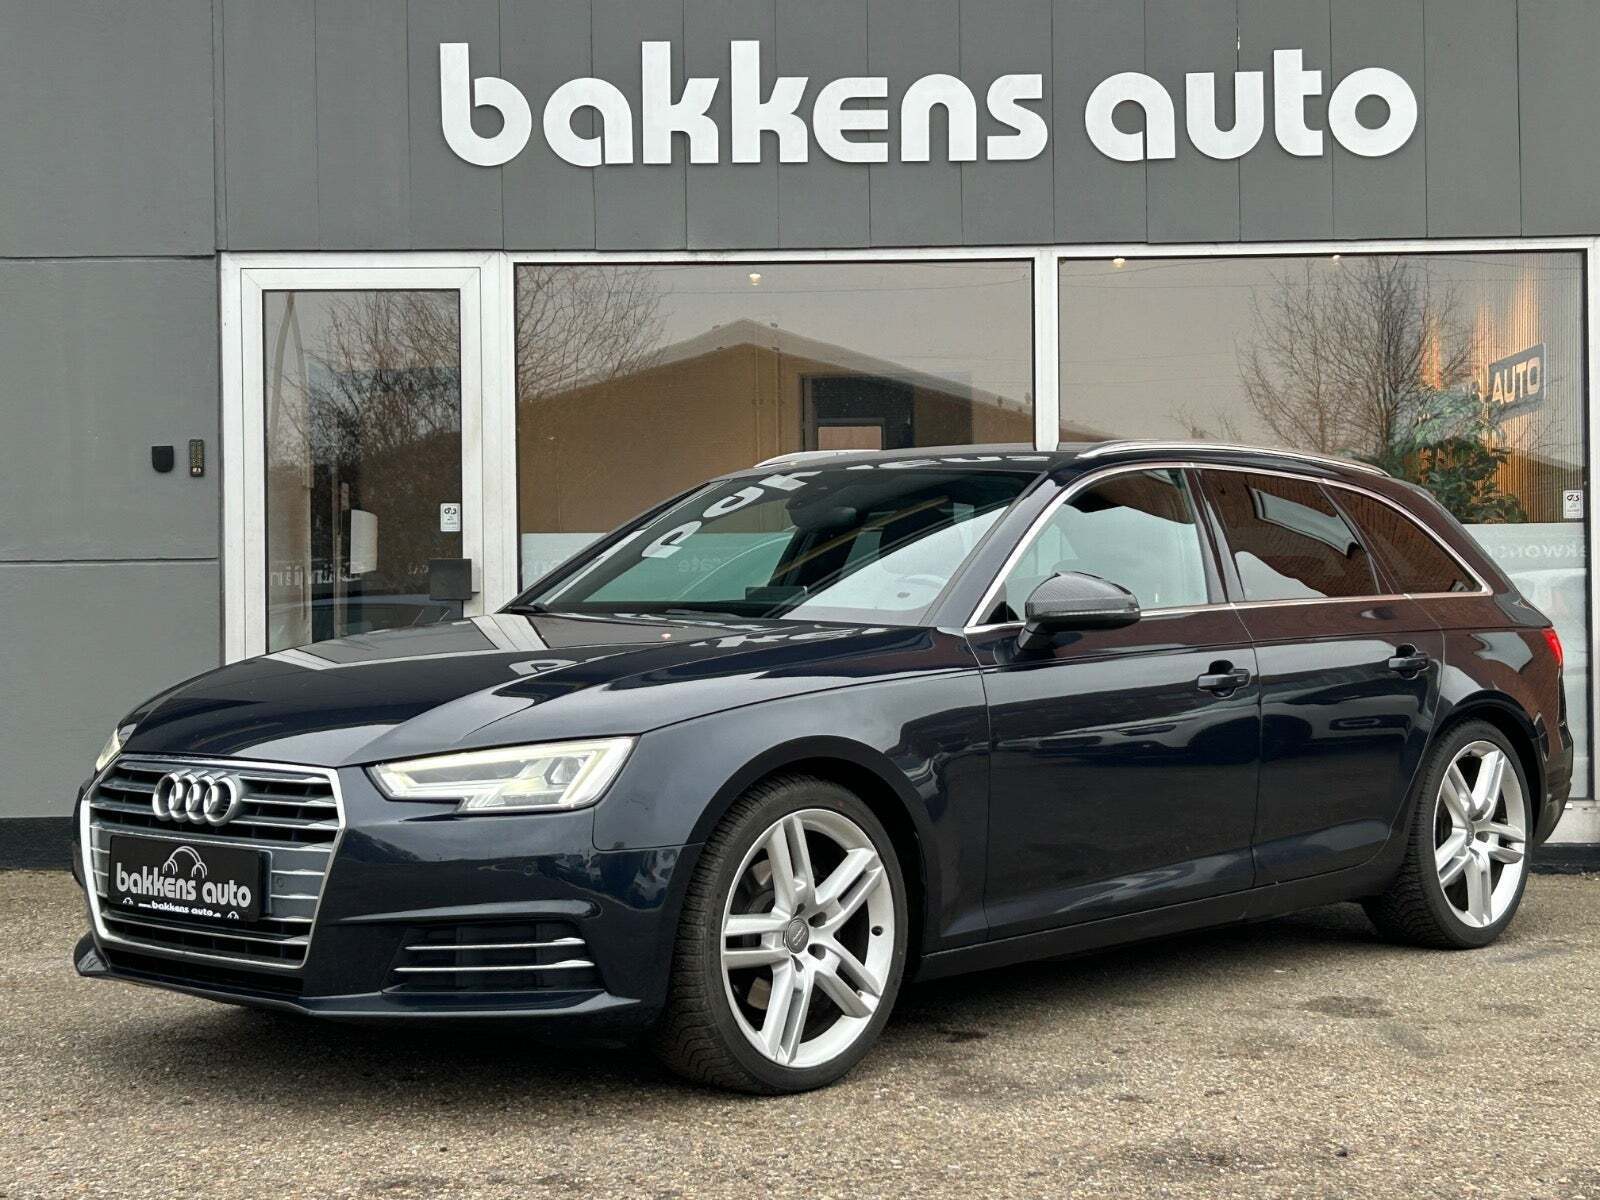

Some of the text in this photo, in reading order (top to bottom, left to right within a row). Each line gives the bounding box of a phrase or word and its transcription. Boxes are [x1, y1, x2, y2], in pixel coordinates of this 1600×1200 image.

[440, 41, 1418, 166] bakkens auto
[1491, 356, 1541, 405] AUTO
[116, 862, 252, 908] bakkens auto
